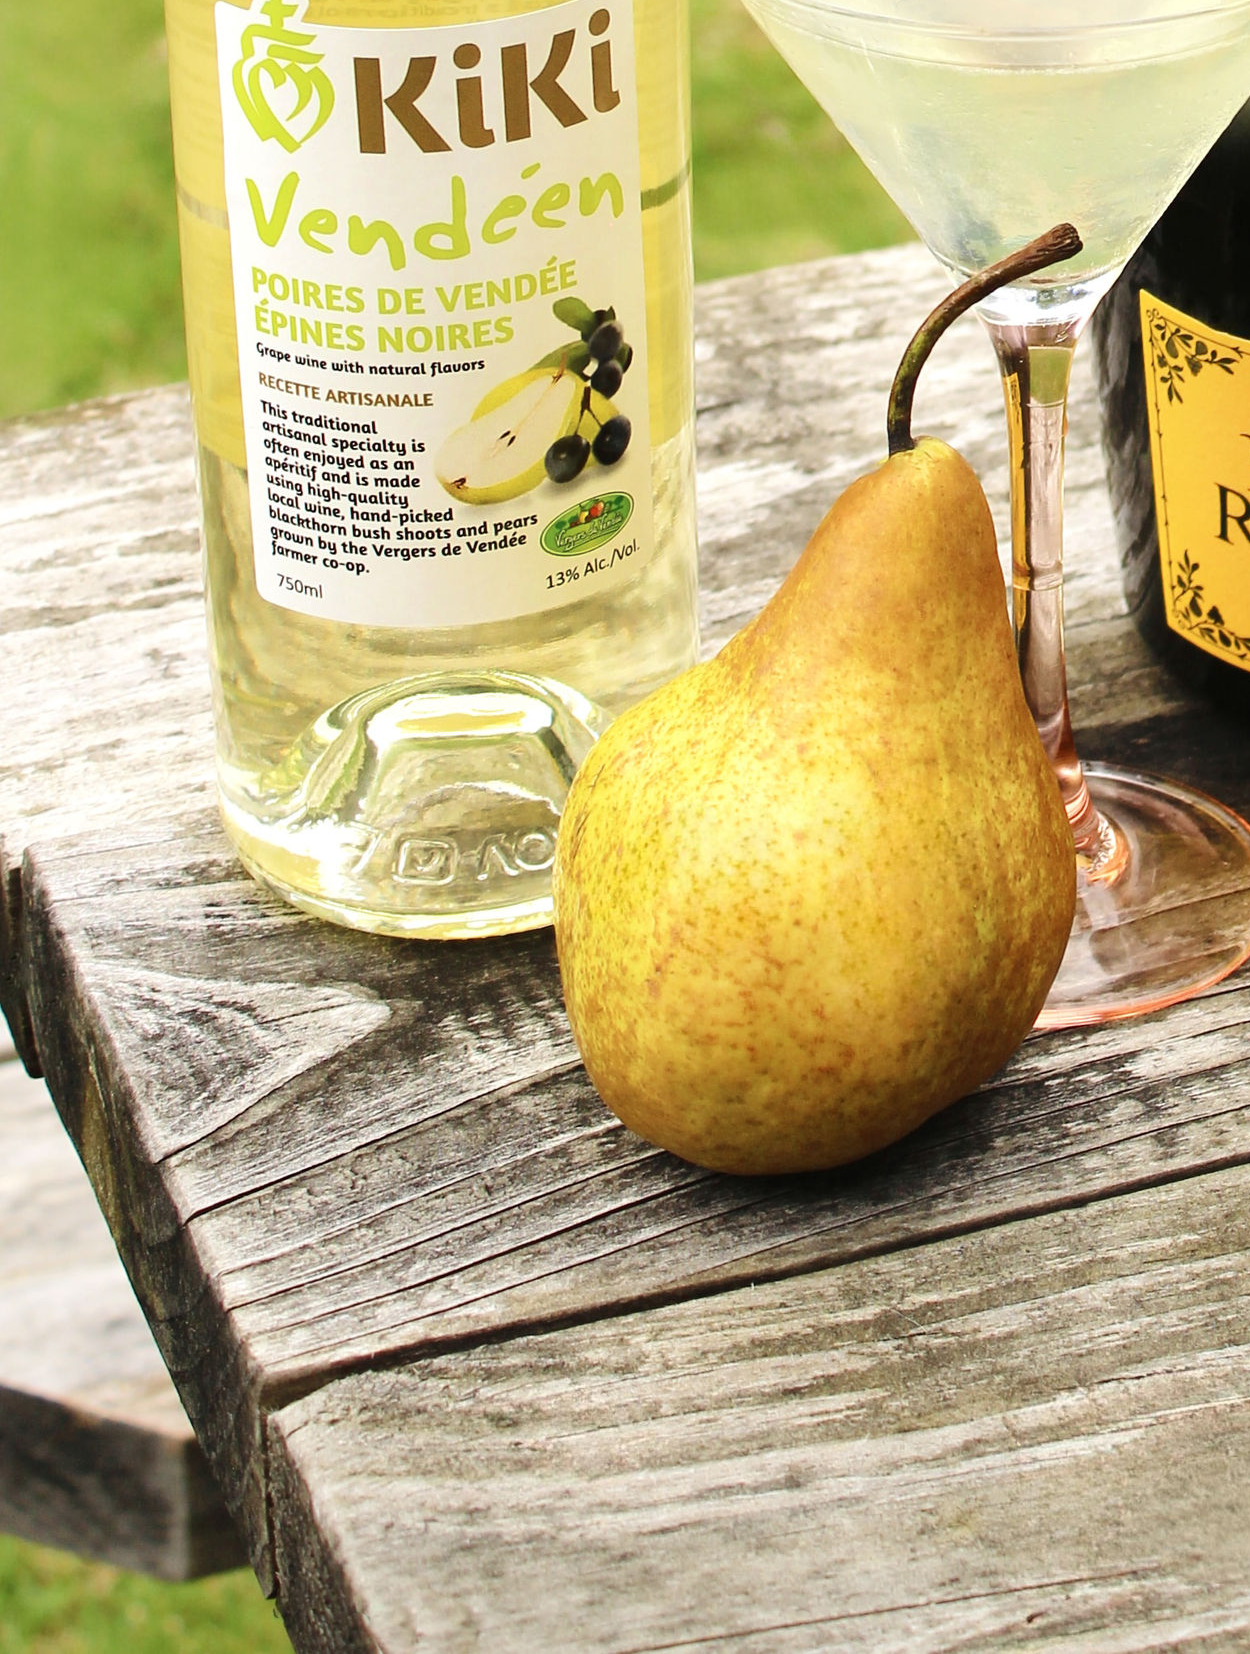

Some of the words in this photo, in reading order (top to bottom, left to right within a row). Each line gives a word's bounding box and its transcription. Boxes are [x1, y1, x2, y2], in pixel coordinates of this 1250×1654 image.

[353, 8, 621, 154] KiKi
[245, 163, 624, 271] Vendéen
[251, 265, 365, 314] POIRES
[377, 287, 426, 315] DE
[435, 255, 578, 313] VENDÉE
[254, 297, 366, 352] ÉPINES
[377, 316, 514, 353] NOIRES
[256, 342, 291, 363] Grape
[295, 354, 327, 370] wine
[331, 360, 364, 374] with
[368, 362, 427, 375] natural
[430, 360, 485, 378] flavors
[259, 372, 321, 400] RECETTE
[325, 389, 434, 407] ARTISANALE
[260, 399, 288, 420] This
[291, 411, 378, 435] traditional
[262, 421, 328, 447] artisanal
[331, 437, 407, 457] specialty
[411, 438, 426, 453] is
[263, 437, 299, 458] often
[303, 449, 365, 470] enjoyed
[369, 459, 389, 470] as
[393, 460, 415, 471] an
[265, 456, 317, 482] apéritif
[321, 471, 351, 485] and
[355, 472, 369, 487] is
[373, 474, 420, 488] made
[266, 473, 304, 497] using
[307, 482, 409, 509] high-quality
[267, 487, 301, 510] local
[304, 501, 345, 521] wine,
[350, 506, 454, 527] hand-picked
[269, 505, 347, 536] blackthorn
[352, 524, 391, 540] bush
[396, 527, 452, 541] shoots
[456, 521, 489, 538] and
[493, 514, 538, 537] pears
[270, 526, 314, 549] grown
[318, 536, 338, 556] by
[341, 541, 368, 556] the
[371, 543, 437, 561] Vergers
[441, 542, 462, 557] de
[465, 531, 527, 554] Vendée
[271, 540, 318, 565] farmer
[322, 557, 370, 576] co-op.
[277, 573, 323, 598] 750ml
[546, 566, 580, 589] 13%
